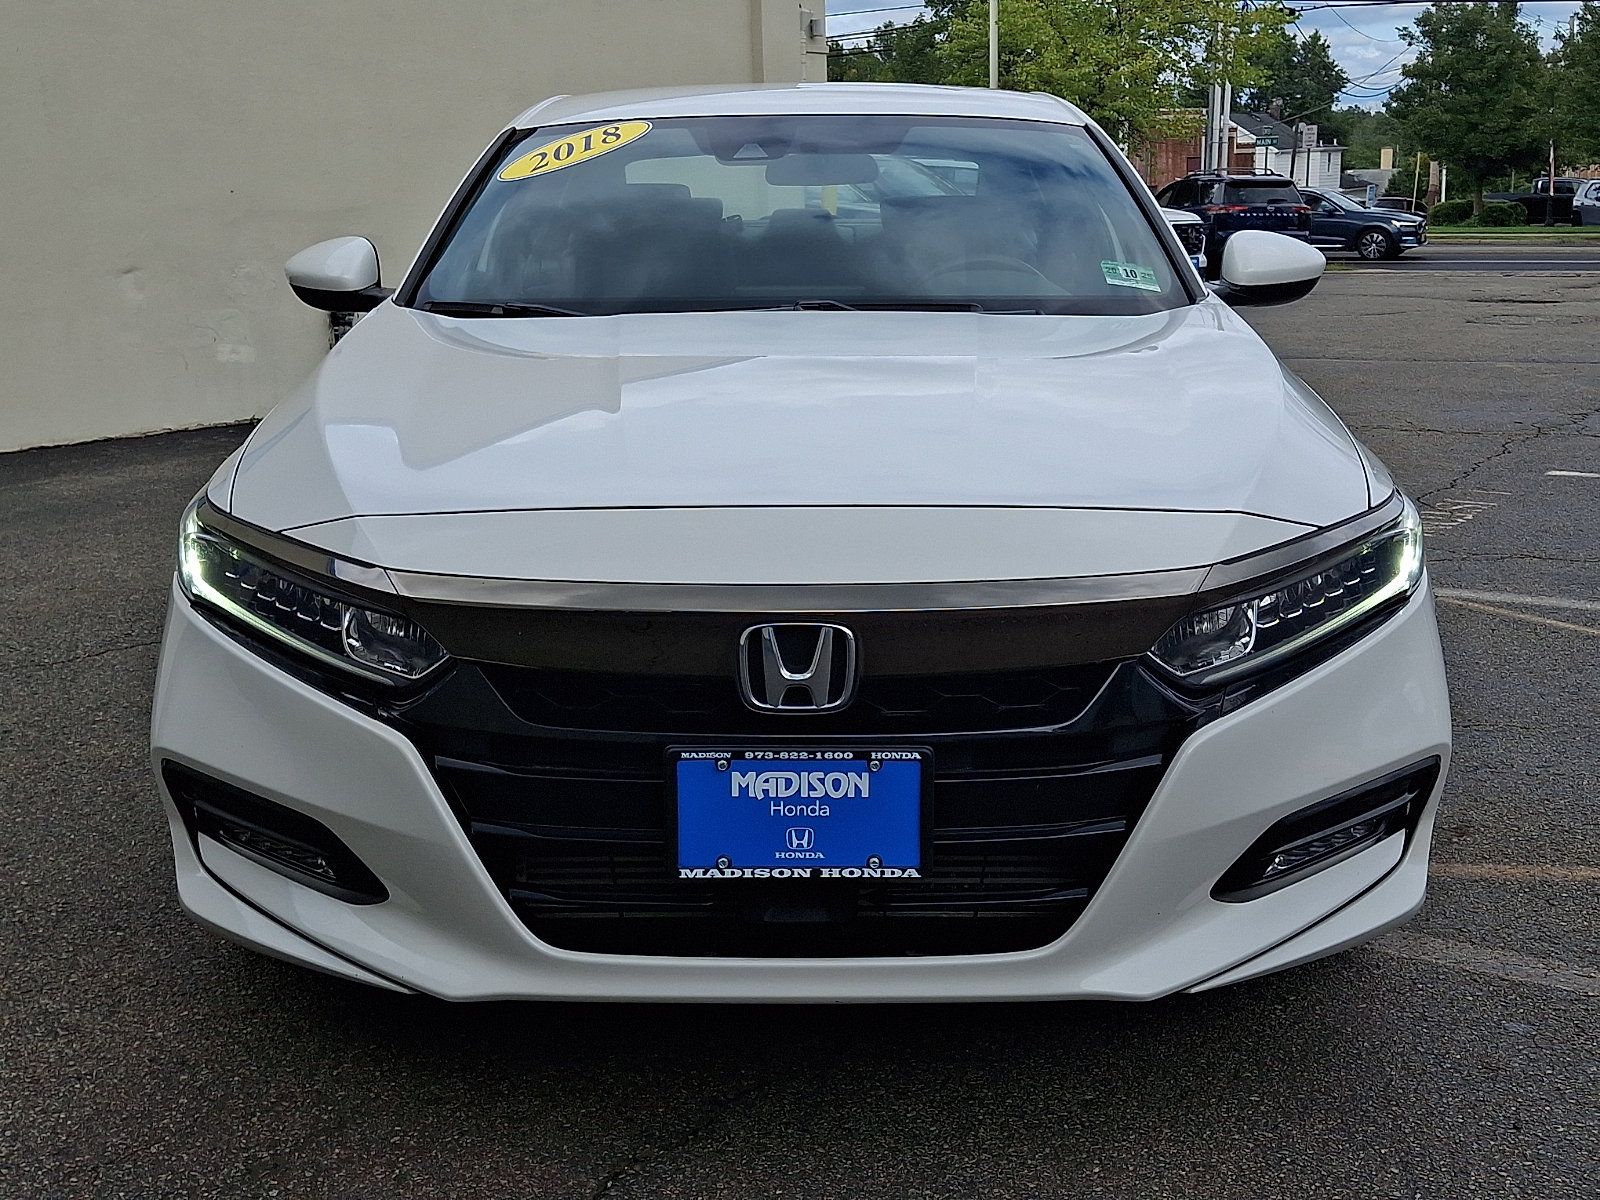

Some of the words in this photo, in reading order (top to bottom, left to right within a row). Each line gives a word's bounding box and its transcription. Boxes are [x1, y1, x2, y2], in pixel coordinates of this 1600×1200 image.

[530, 126, 622, 173] 2018
[1123, 268, 1138, 278] 10
[744, 751, 854, 759] 973-822-1600
[731, 771, 869, 800] MADISON
[770, 800, 830, 817] Honda
[775, 851, 825, 859] HONDA
[679, 868, 812, 878] MADISON
[820, 868, 922, 878] HONDA
